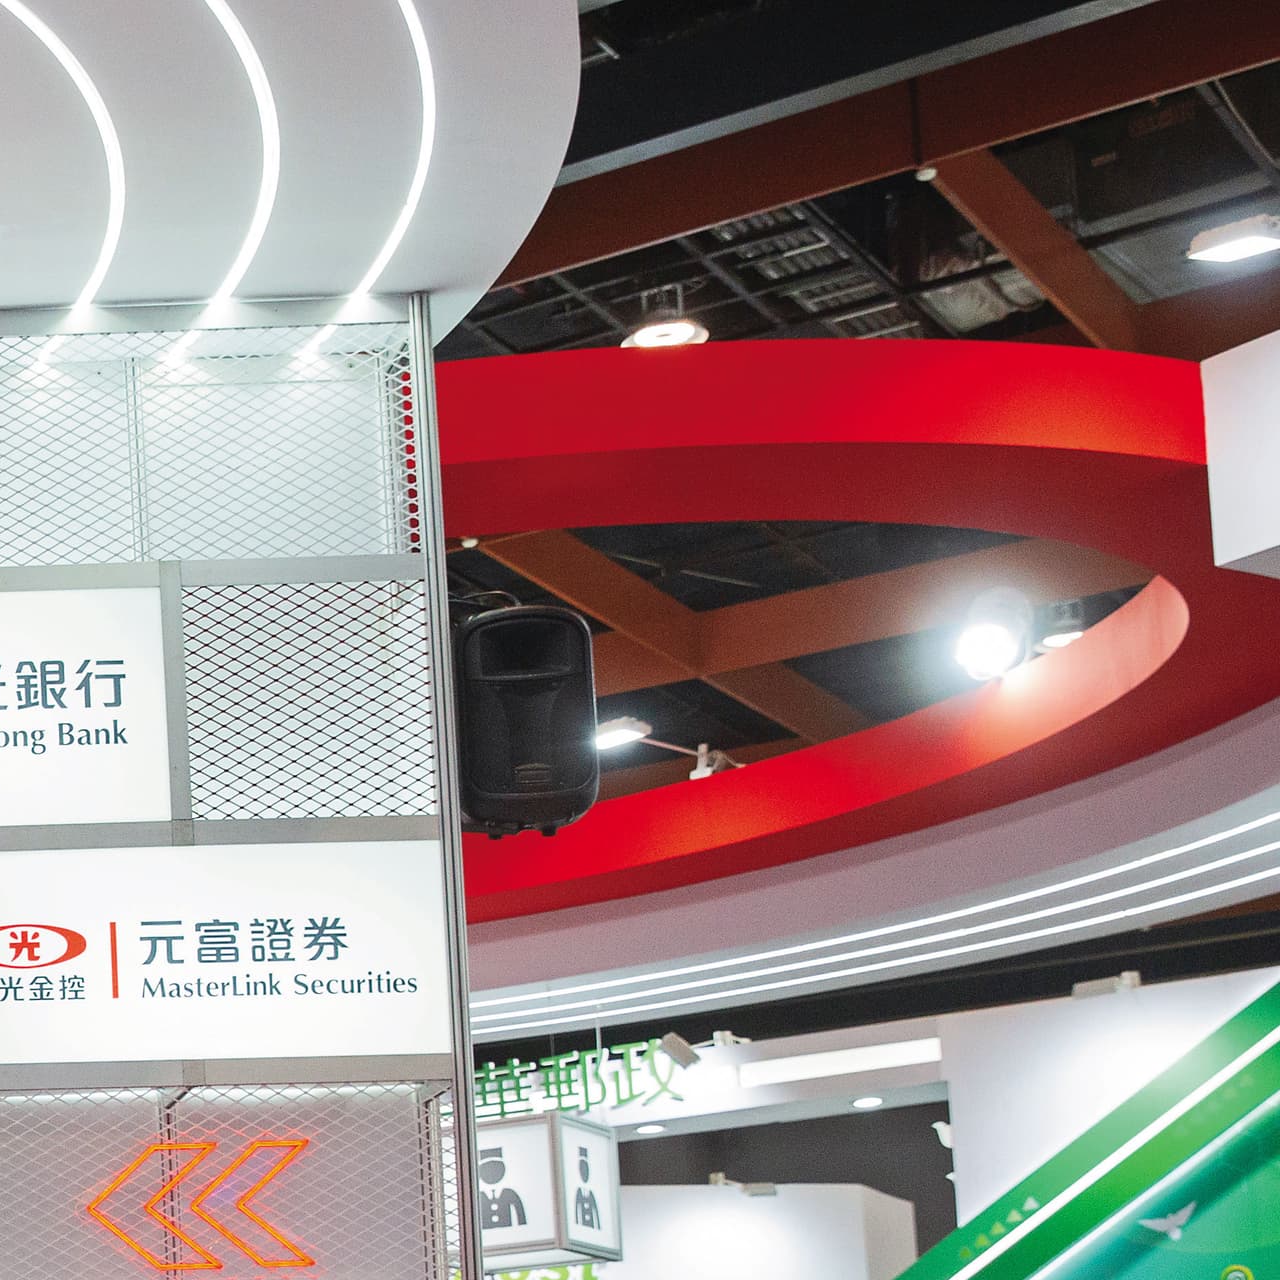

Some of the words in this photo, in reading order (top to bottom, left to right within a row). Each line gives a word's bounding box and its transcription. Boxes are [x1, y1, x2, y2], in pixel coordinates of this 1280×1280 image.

[57, 719, 129, 746] Bank
[139, 916, 349, 966] 元富證券
[141, 972, 282, 999] MasterLink
[293, 970, 418, 996] Securities
